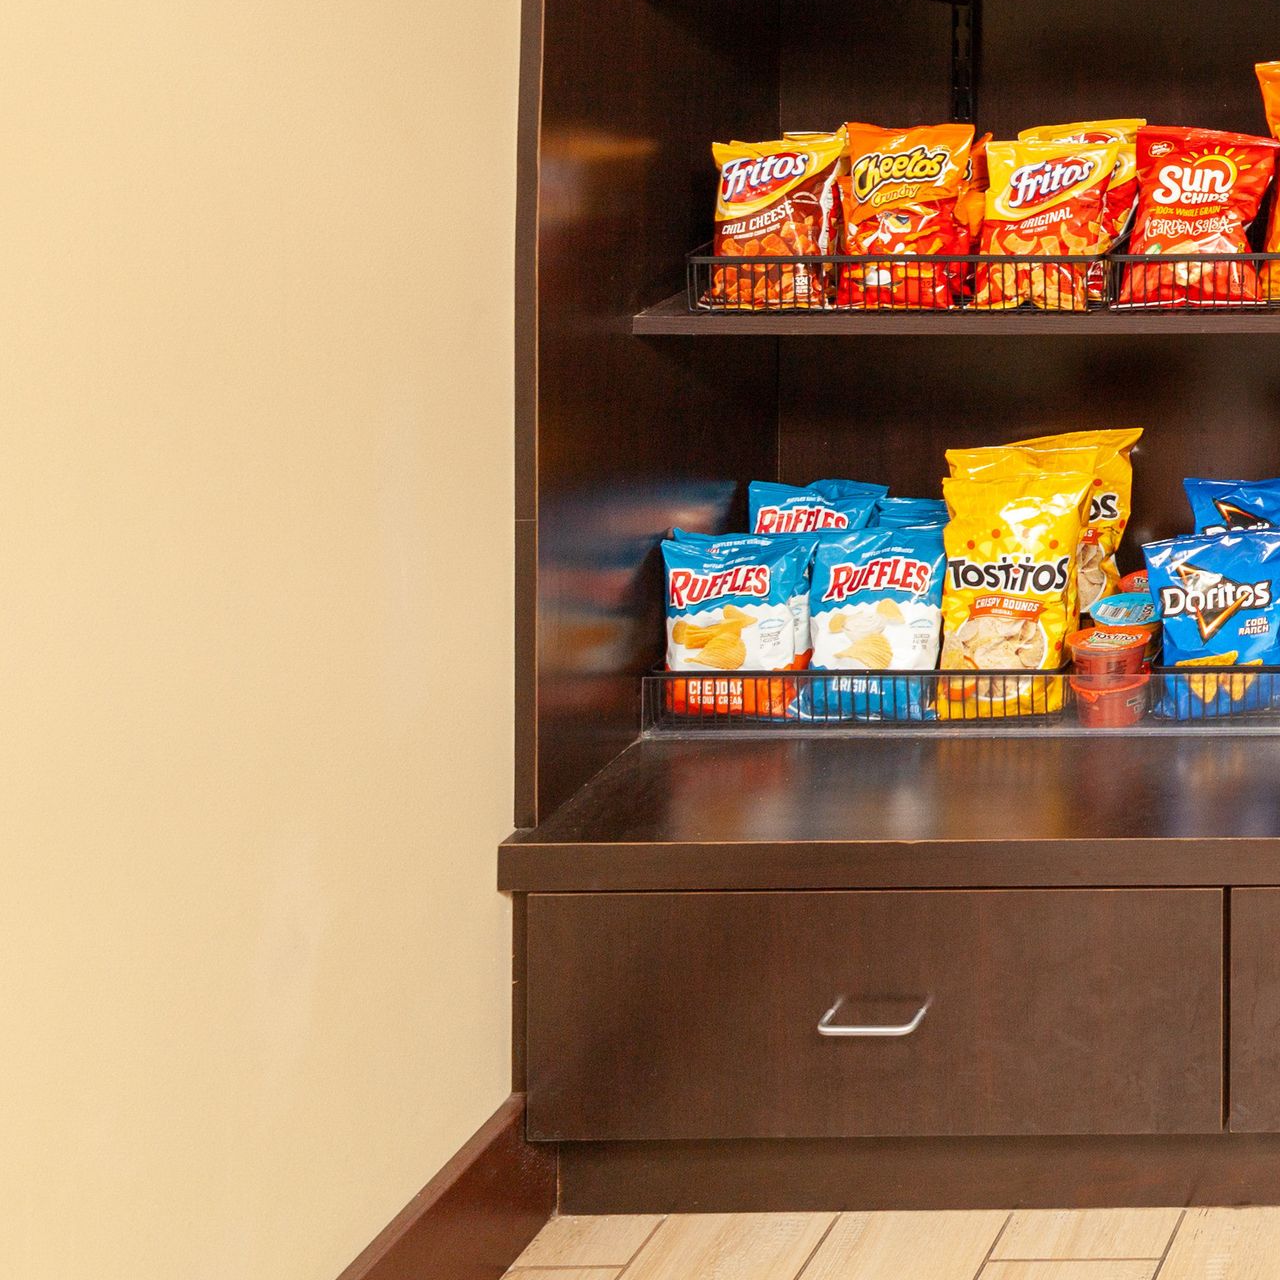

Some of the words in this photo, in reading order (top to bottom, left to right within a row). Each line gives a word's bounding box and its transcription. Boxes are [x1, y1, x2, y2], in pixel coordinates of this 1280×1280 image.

[723, 152, 809, 199] Fritos
[853, 148, 949, 198] Cheetos
[1009, 158, 1095, 207] Fritos
[872, 185, 920, 208] Crunchy
[1155, 206, 1174, 215] 100%
[1176, 206, 1198, 215] WHOLE
[1200, 205, 1221, 214] GRAIN
[1180, 190, 1229, 204] CHIPS
[669, 565, 770, 609] RUFFLES
[823, 557, 931, 602] RUFFLES
[947, 555, 1071, 592] TOSTITOS
[973, 597, 1001, 612] CRISPY
[1002, 600, 1039, 613] ROUNDS
[1162, 580, 1271, 615] Doritos
[1238, 625, 1270, 635] RANCH
[1244, 618, 1269, 627] COOL
